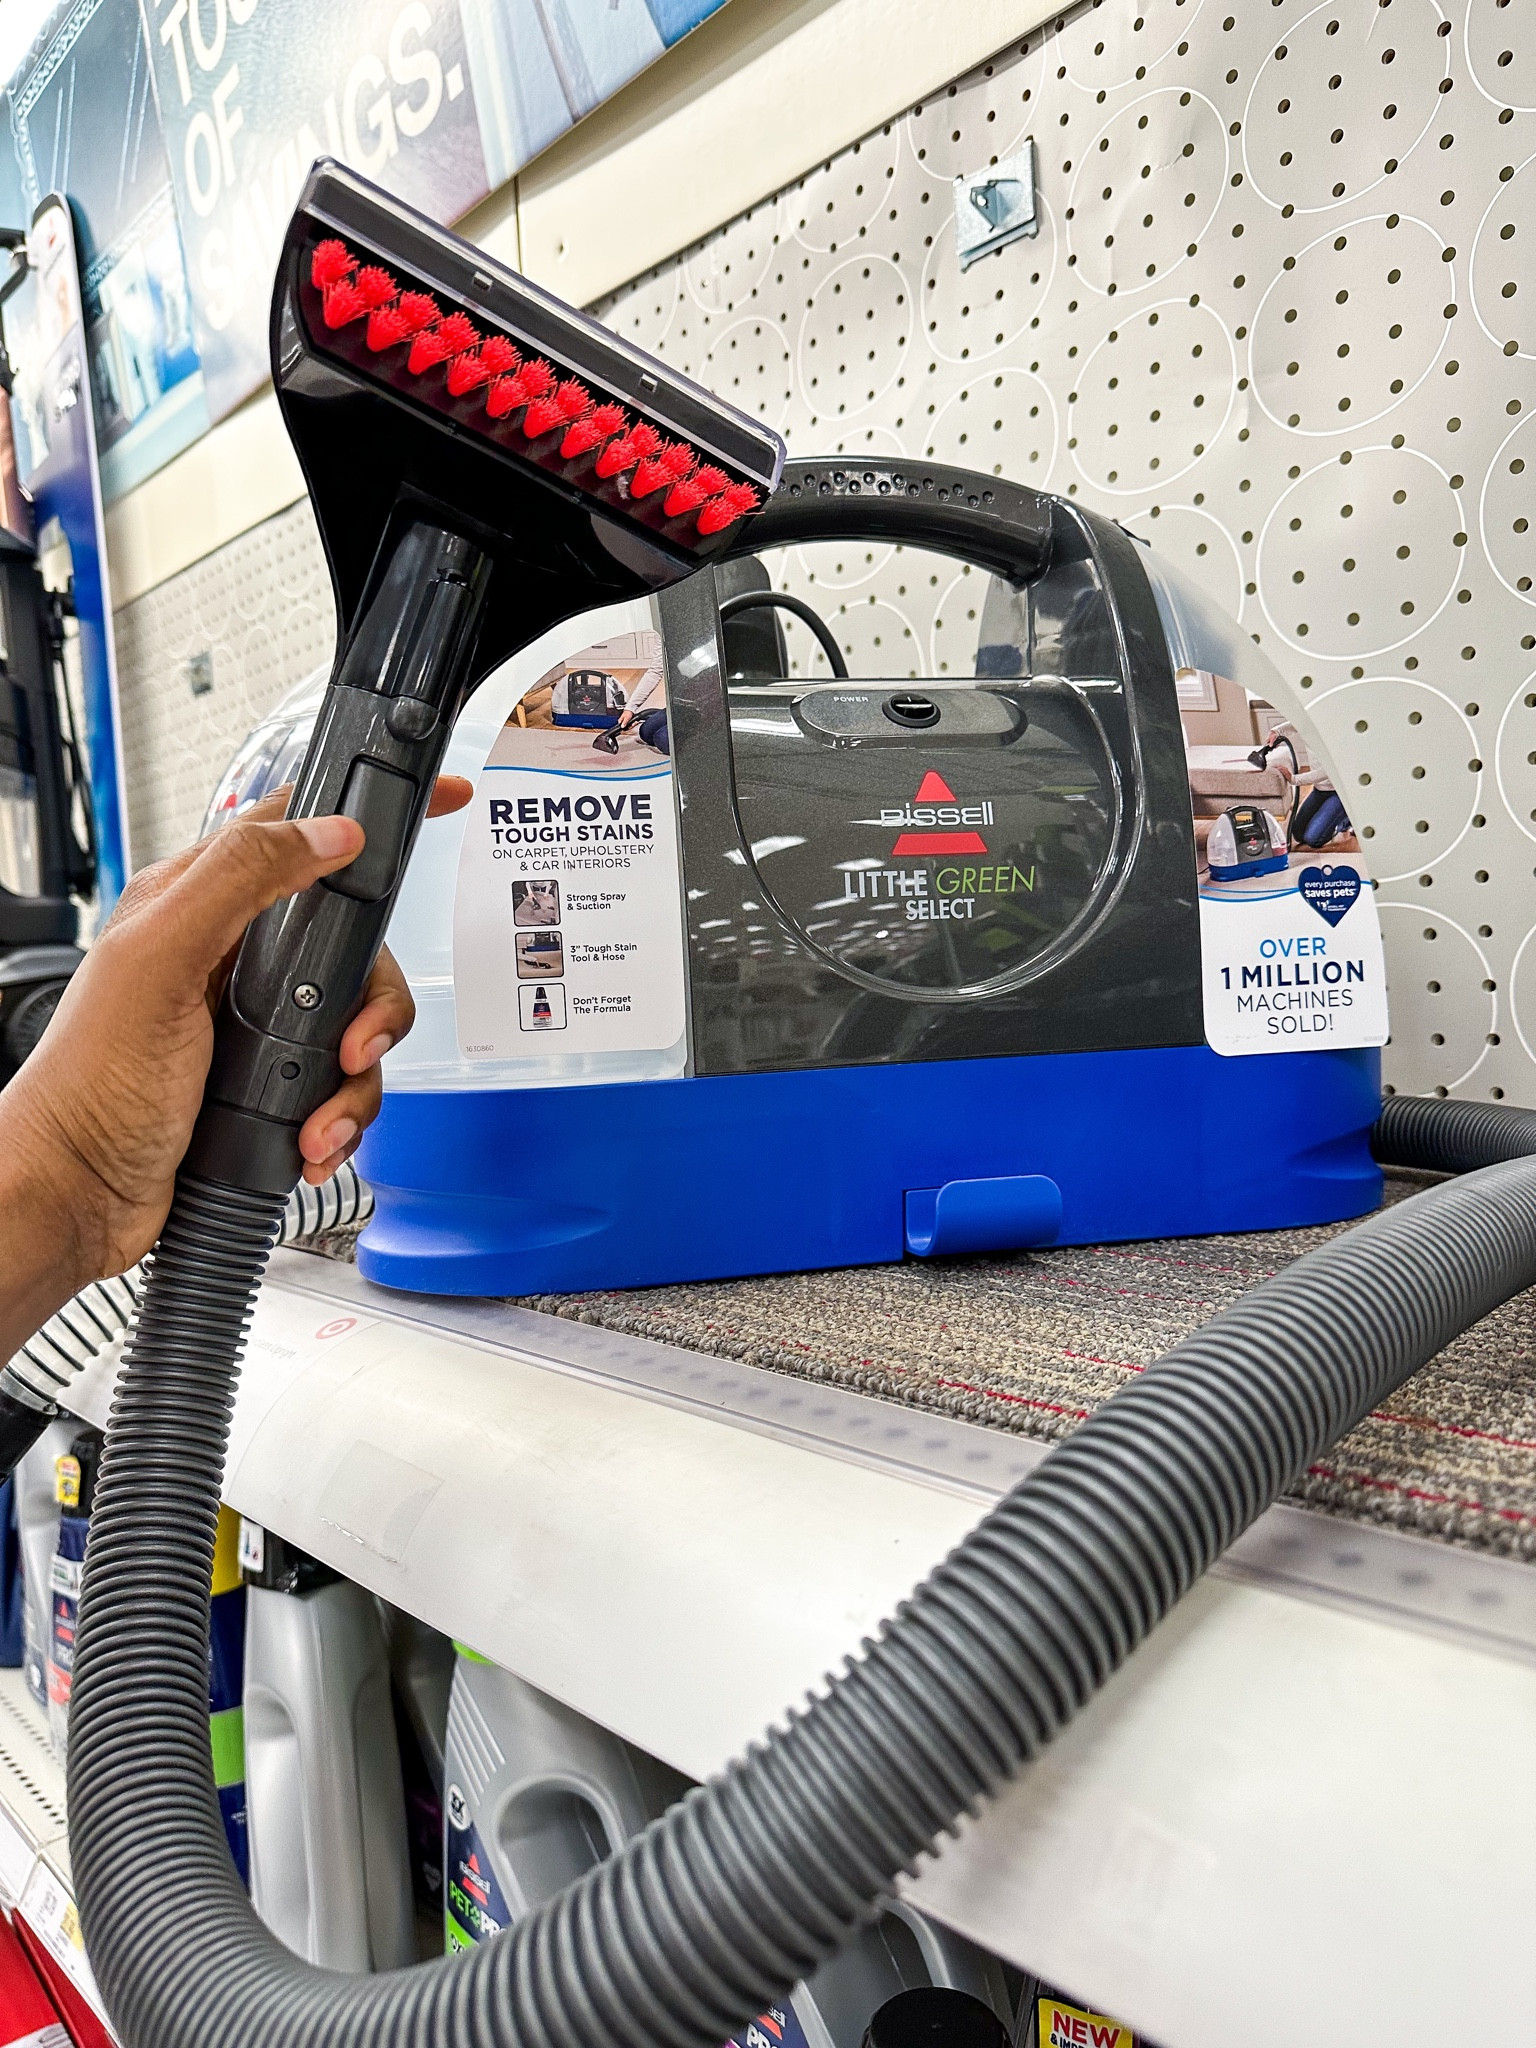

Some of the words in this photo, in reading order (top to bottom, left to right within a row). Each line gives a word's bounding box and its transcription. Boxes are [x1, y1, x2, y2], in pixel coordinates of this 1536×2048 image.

[184, 63, 244, 217] OF
[833, 695, 869, 703] POWER
[489, 793, 653, 825] REMOVE
[490, 826, 570, 844] TOUGH
[577, 824, 654, 842] STAINS
[492, 848, 513, 860] ON
[515, 846, 568, 860] CARPET,
[570, 844, 655, 858] UPHOLSTERY
[520, 861, 529, 872] &
[532, 859, 560, 871] CAR
[563, 857, 631, 871] INTERIORS
[844, 869, 928, 899] LITTLE
[936, 865, 1036, 895] GREEN
[1304, 881, 1323, 889] every
[1324, 880, 1356, 889] purchase
[566, 893, 598, 902] Strong
[600, 892, 627, 902] Spray
[1305, 888, 1332, 898] saves
[567, 902, 574, 911] &
[576, 901, 611, 911] Suction
[905, 898, 976, 921] SELECT
[583, 943, 612, 954] Tough
[614, 942, 638, 952] Stain
[1259, 936, 1327, 959] OVER
[571, 953, 591, 963] Tool
[593, 953, 600, 962] &
[602, 952, 625, 962] Hose
[1220, 966, 1231, 990] 1
[1241, 959, 1365, 989] MILLION
[572, 996, 599, 1006] Don't
[601, 995, 632, 1006] Forget
[574, 1005, 591, 1015] The
[593, 1004, 631, 1014] Formula
[1237, 988, 1353, 1013] MACHINES
[1267, 1013, 1334, 1035] SOLD!
[450, 1879, 472, 1918] PET
[479, 1910, 506, 1940] PR
[1052, 2009, 1121, 2048] NEW
